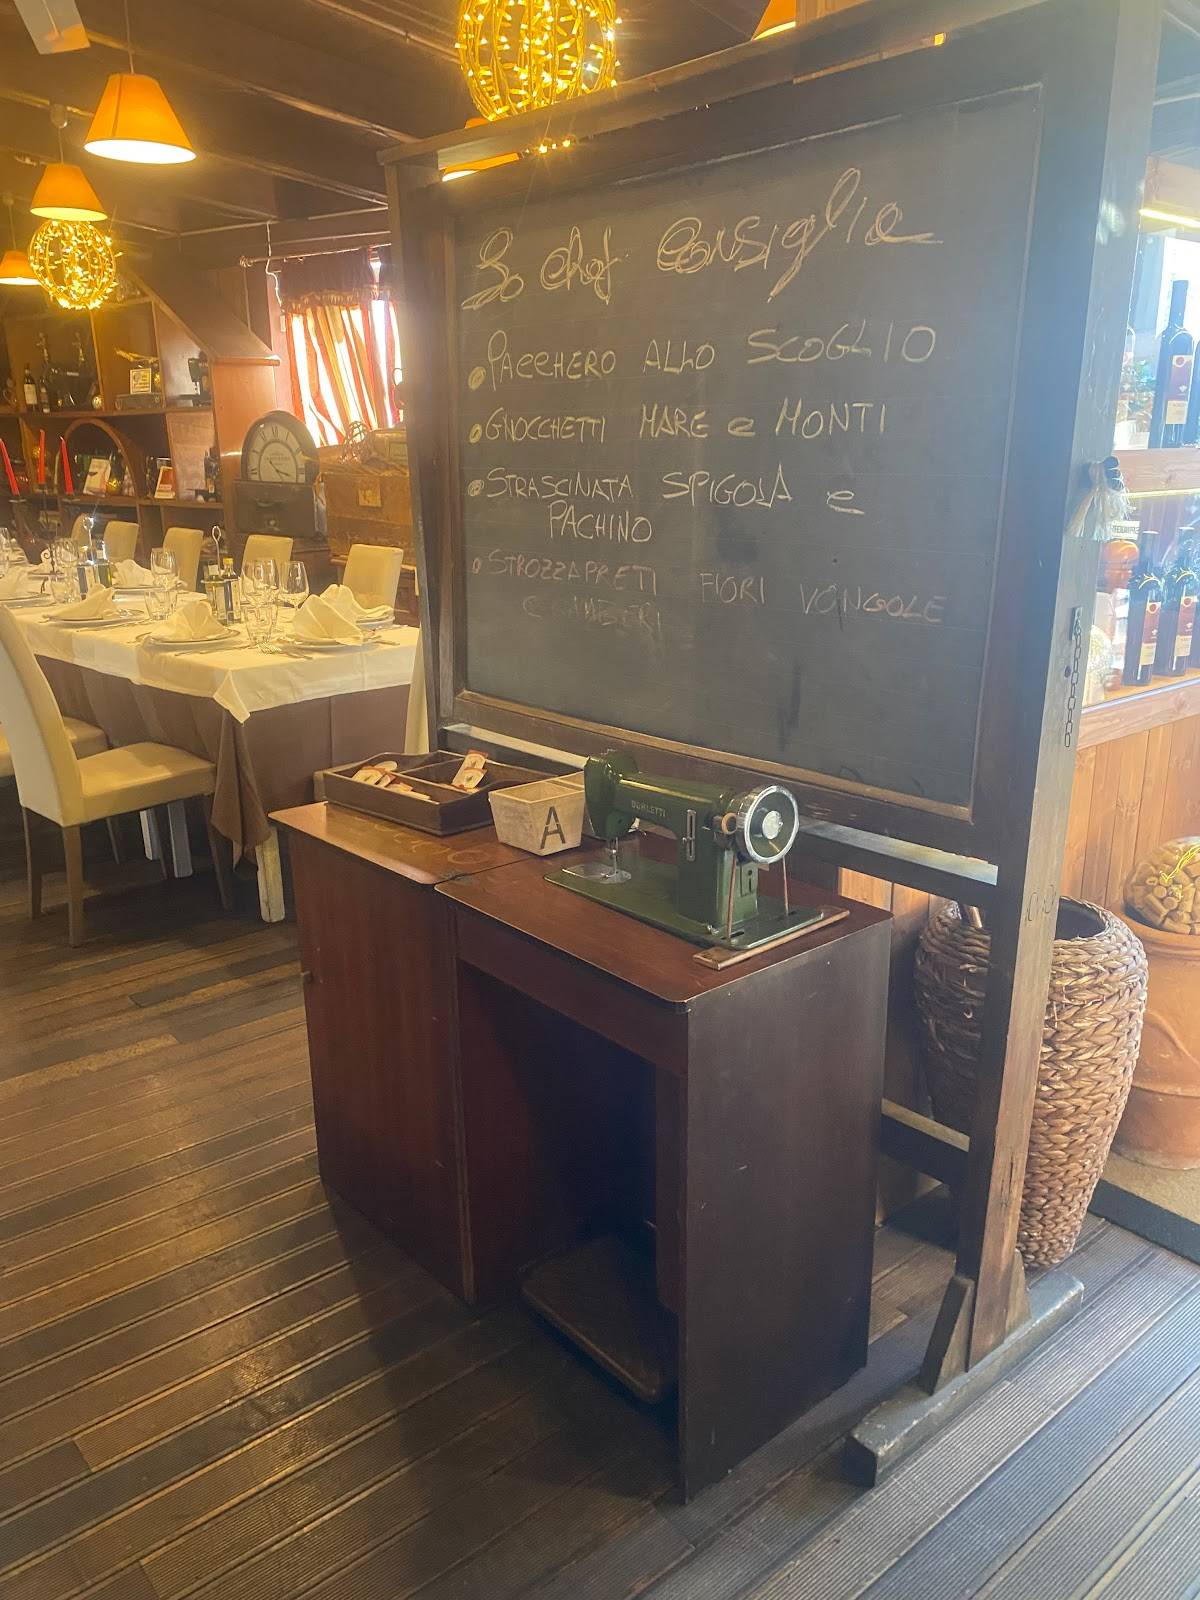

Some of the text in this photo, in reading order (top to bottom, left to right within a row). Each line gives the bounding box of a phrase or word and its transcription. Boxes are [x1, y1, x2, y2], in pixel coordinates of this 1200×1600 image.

[642, 339, 715, 375] ALLO
[747, 320, 937, 364] SCOGLIO
[485, 407, 606, 443] GNOCCHETTI
[639, 403, 709, 439] MARE
[775, 397, 887, 439] MONTI
[486, 467, 635, 502] STRASCINATA
[662, 463, 792, 507] SPIGOLA
[548, 499, 653, 543] PACHINO
[487, 550, 947, 624] STROZZAPRETI FIORI VONGOLE
[540, 806, 566, 849] A
